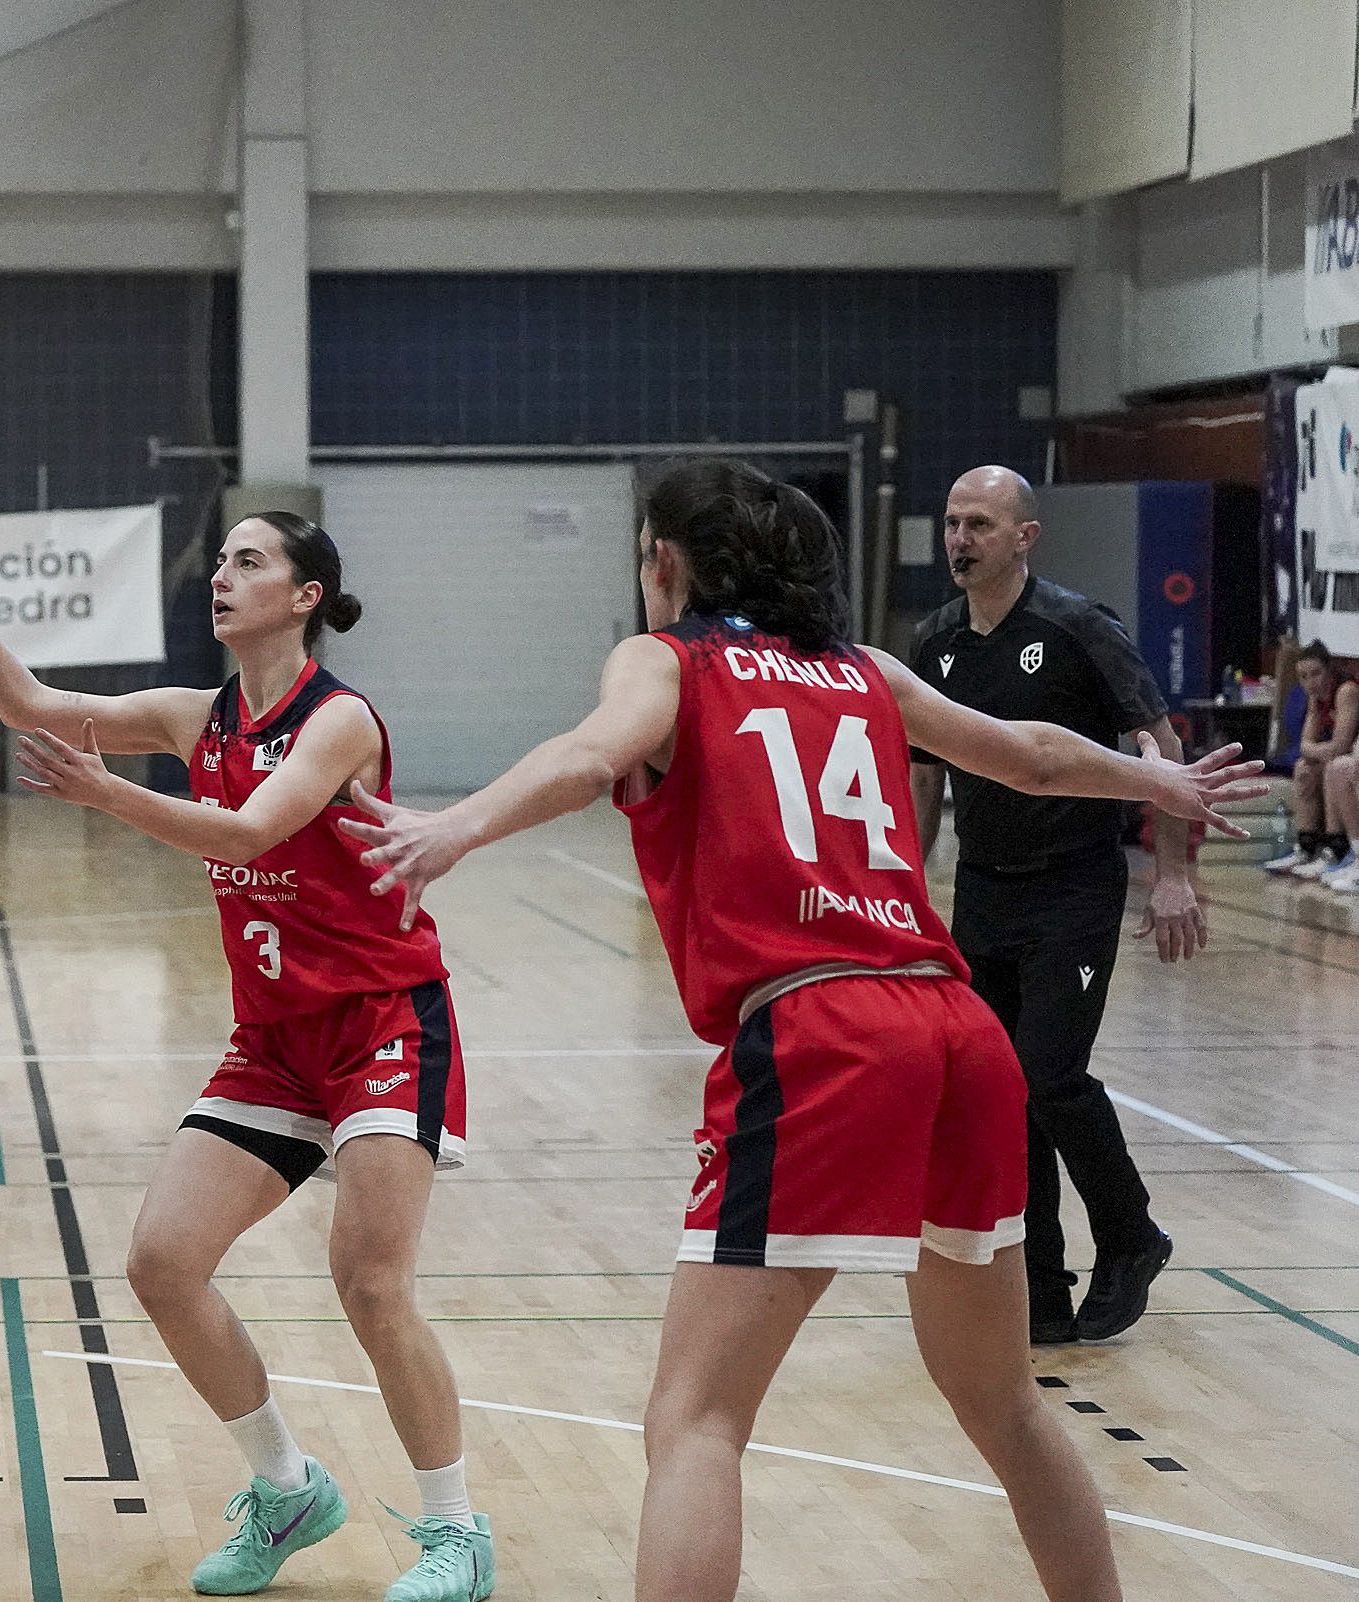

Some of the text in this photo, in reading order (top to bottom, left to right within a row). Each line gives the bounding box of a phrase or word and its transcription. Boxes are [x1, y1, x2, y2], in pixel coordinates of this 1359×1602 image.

[724, 646, 869, 694] CHENLO
[734, 707, 914, 872] 14
[243, 920, 281, 980] 3
